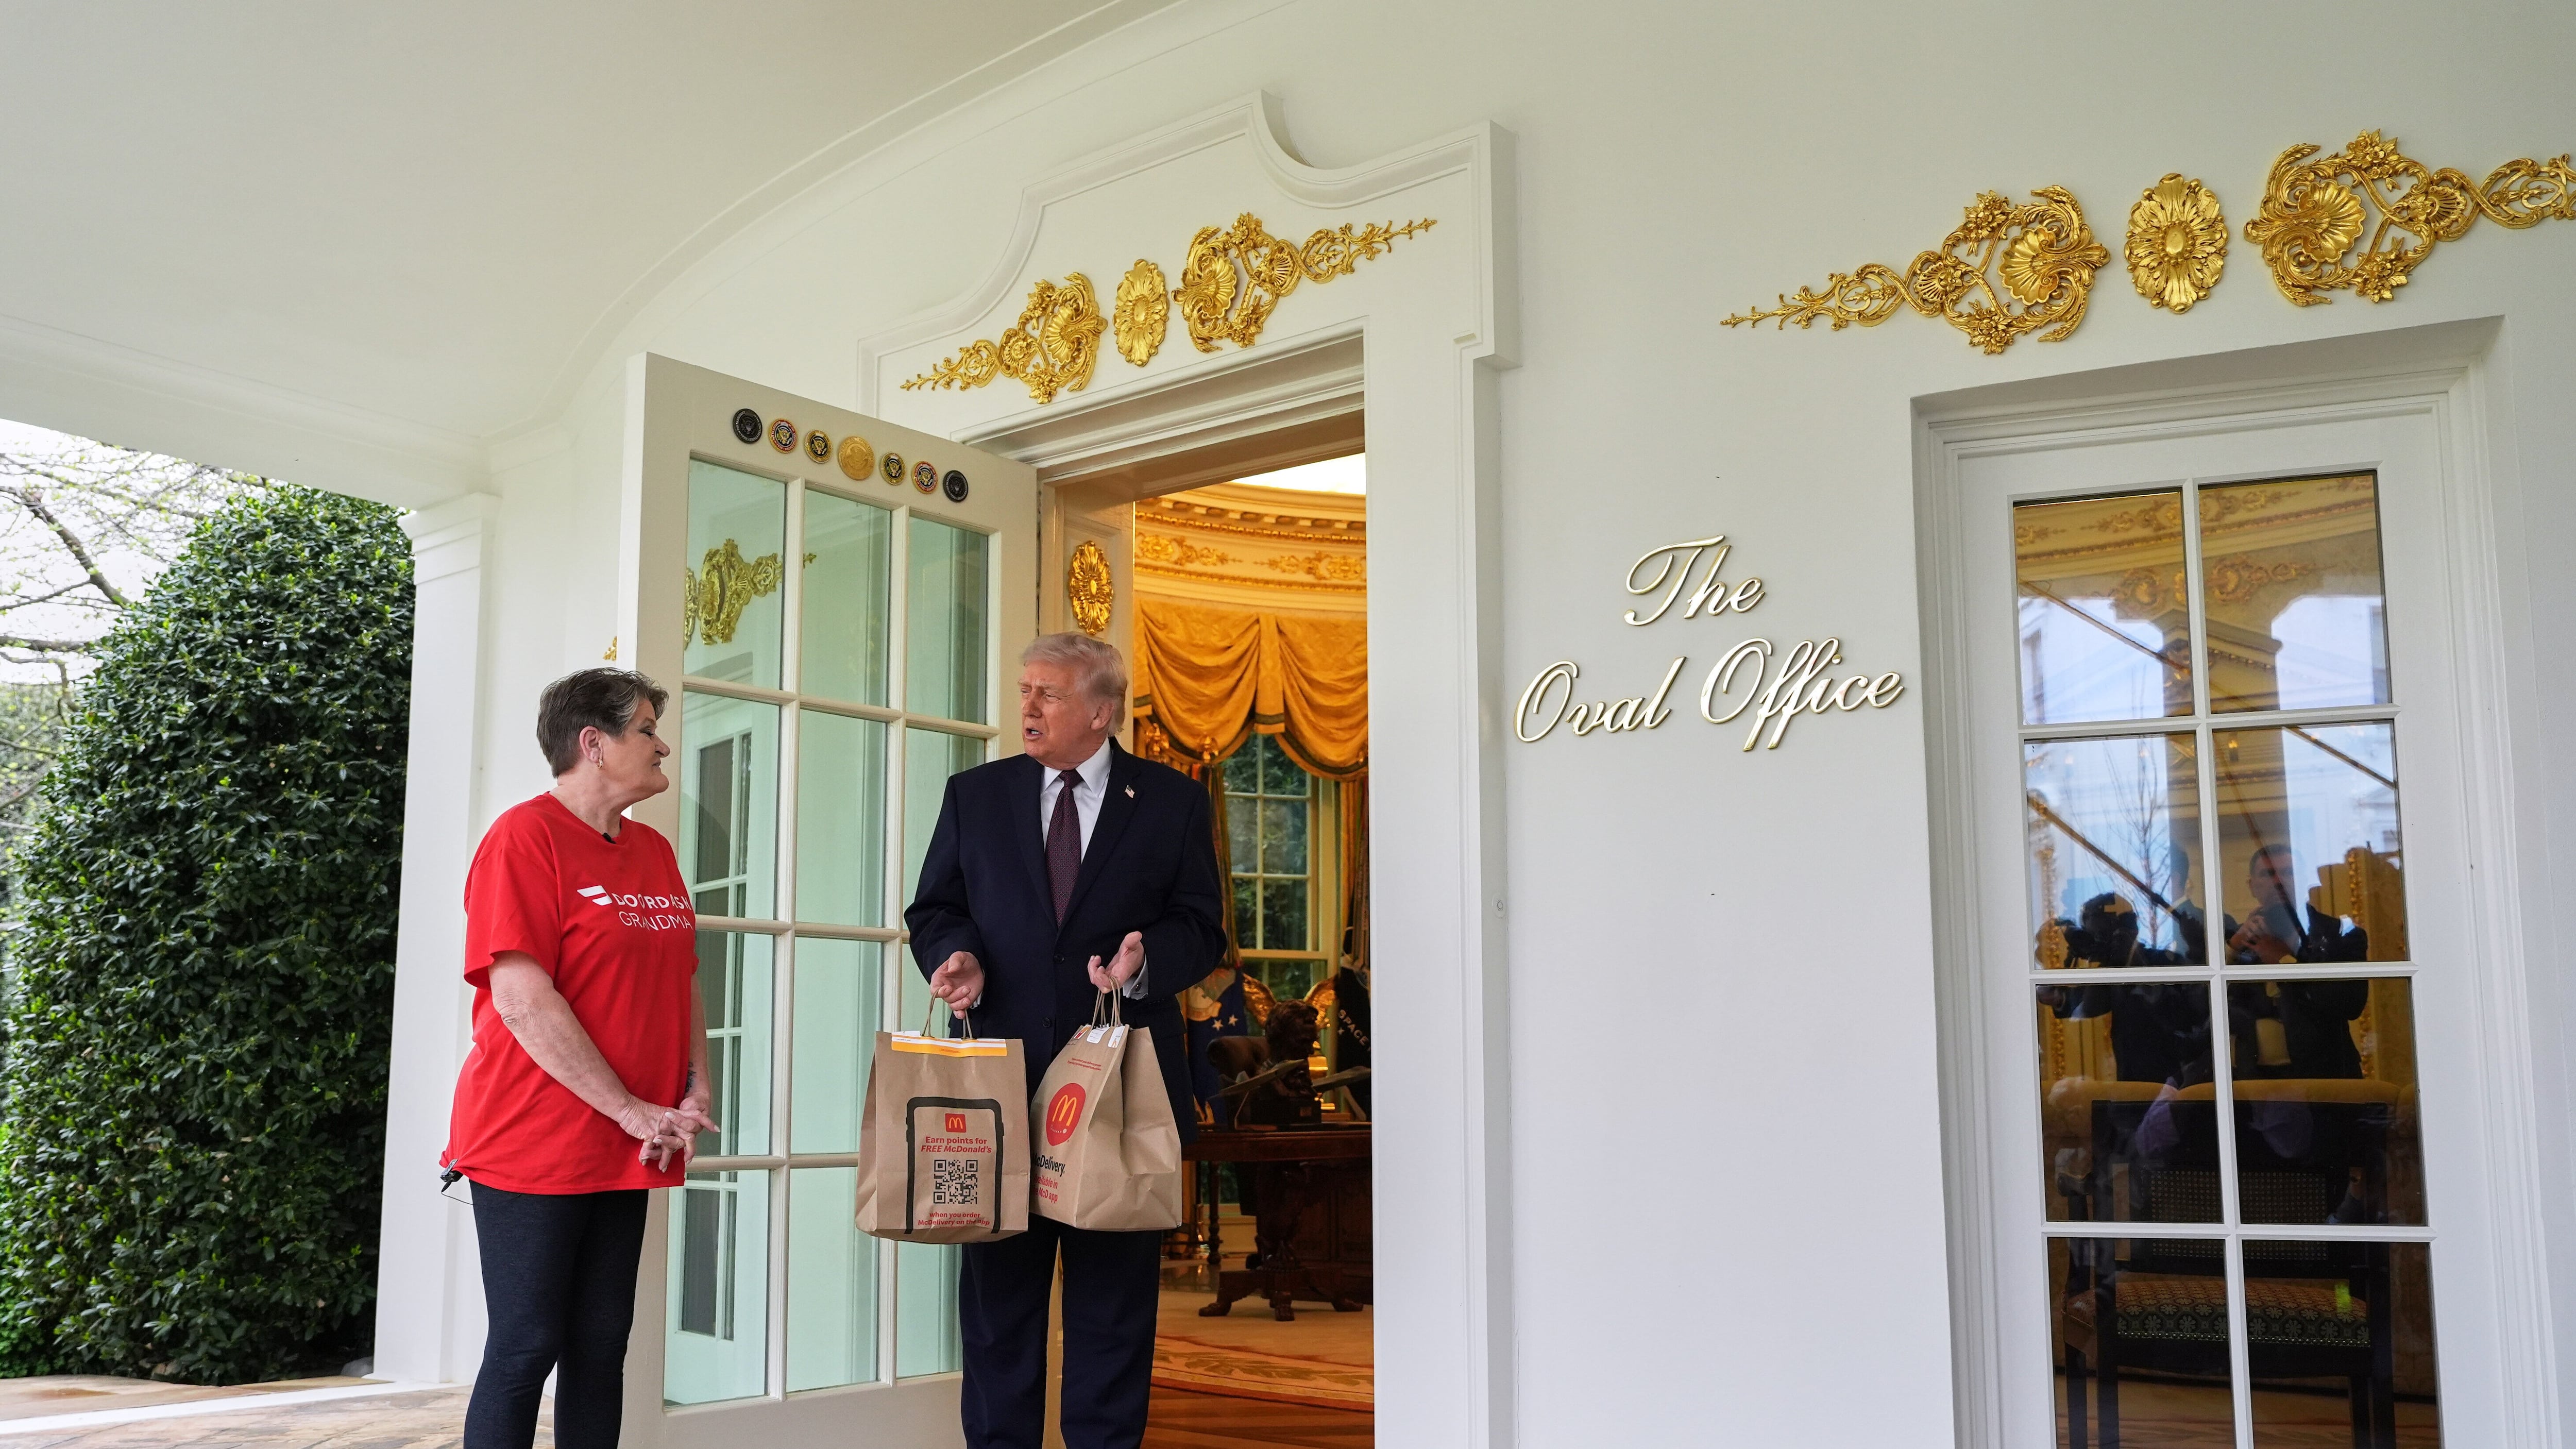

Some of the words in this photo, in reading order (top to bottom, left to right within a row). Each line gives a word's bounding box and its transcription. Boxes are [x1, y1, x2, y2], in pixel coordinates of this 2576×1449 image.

[1624, 534, 1766, 626] The
[1514, 656, 1688, 743] Oval
[1700, 637, 1905, 752] Office
[611, 892, 692, 910] DOORDASH
[619, 911, 693, 931] GRANDMA
[1338, 1009, 1369, 1046] SPACE
[947, 1137, 973, 1145] points
[1053, 1178, 1058, 1189] in
[1039, 1187, 1048, 1199] McD
[1048, 1192, 1058, 1204] app
